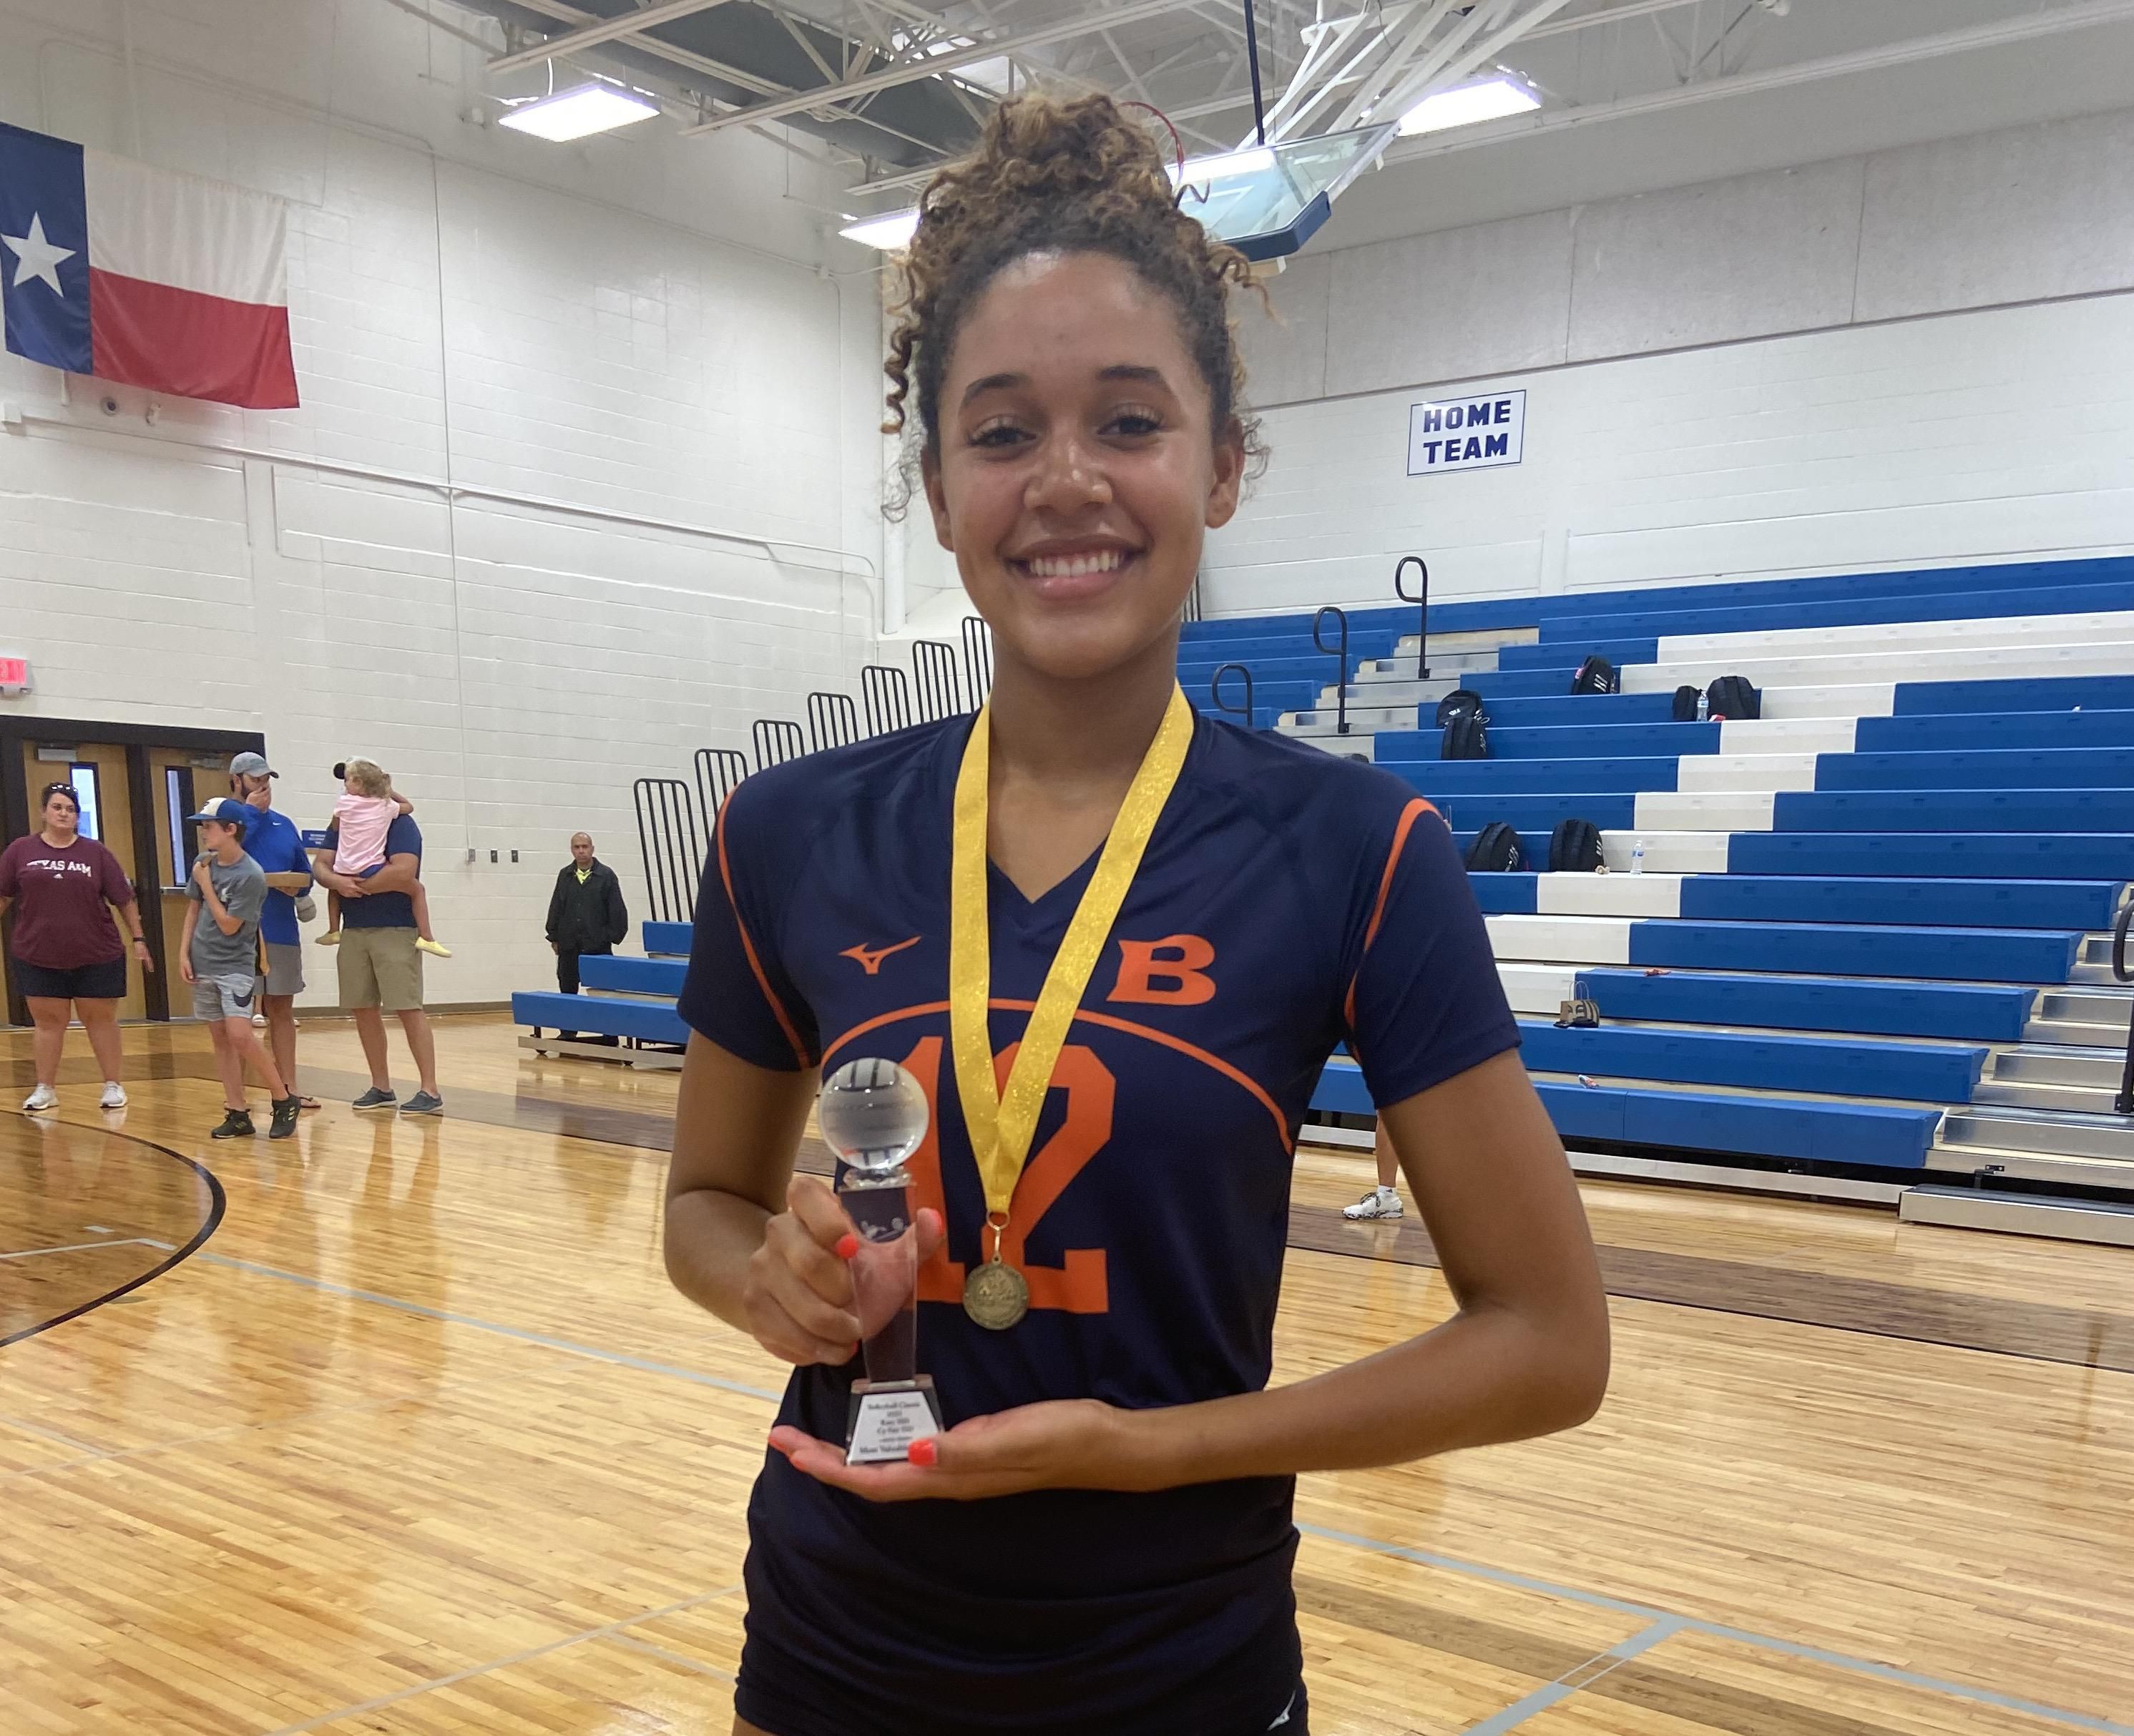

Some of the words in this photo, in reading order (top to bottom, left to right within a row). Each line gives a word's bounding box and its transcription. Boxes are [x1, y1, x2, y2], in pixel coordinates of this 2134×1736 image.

[1424, 400, 1511, 433] HOME
[1423, 433, 1508, 464] TEAM
[1105, 933, 1216, 1006] B
[897, 1036, 1117, 1314] 12
